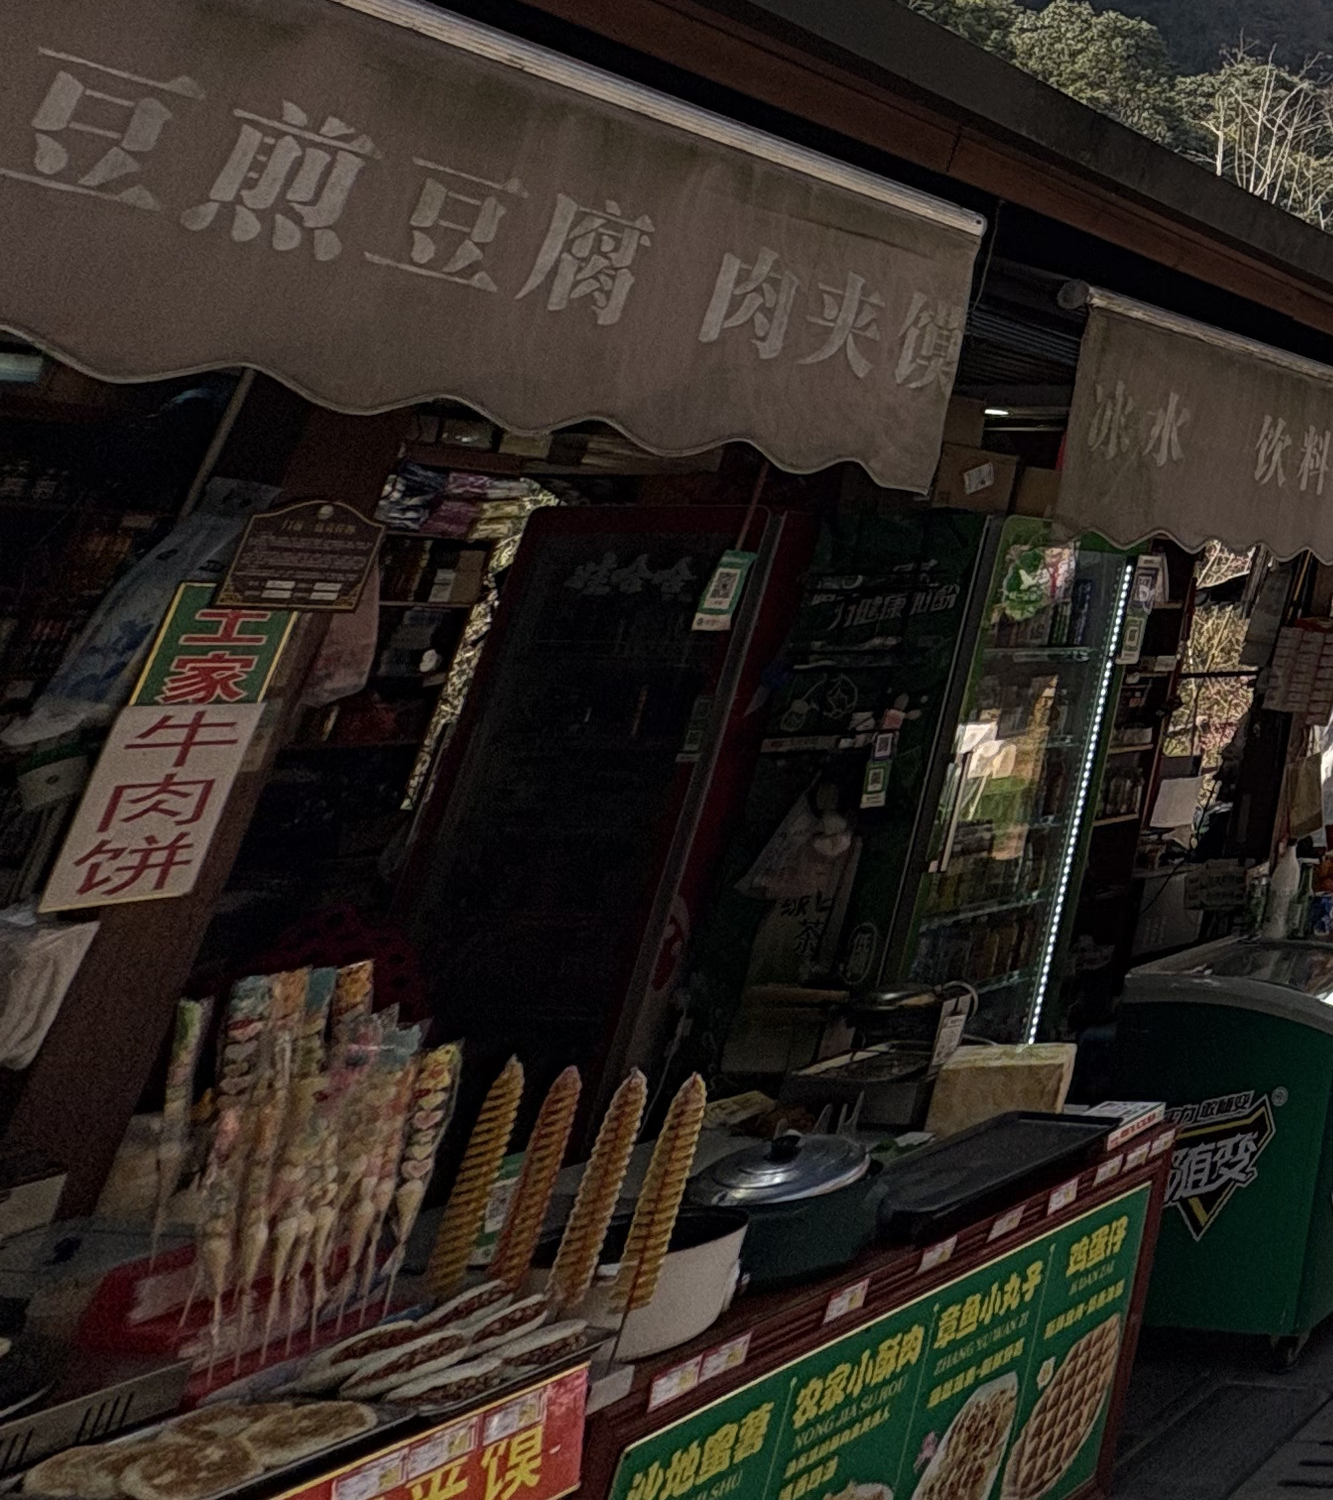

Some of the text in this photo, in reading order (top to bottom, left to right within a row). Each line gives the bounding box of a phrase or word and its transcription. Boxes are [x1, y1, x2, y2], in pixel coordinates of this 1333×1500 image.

[698, 246, 966, 394] 肉夹馍
[1088, 380, 1191, 468] 冰水
[1253, 414, 1331, 496] 饮料
[74, 711, 238, 896] 牛肉饼
[933, 1260, 1044, 1350] 章鱼小丸子
